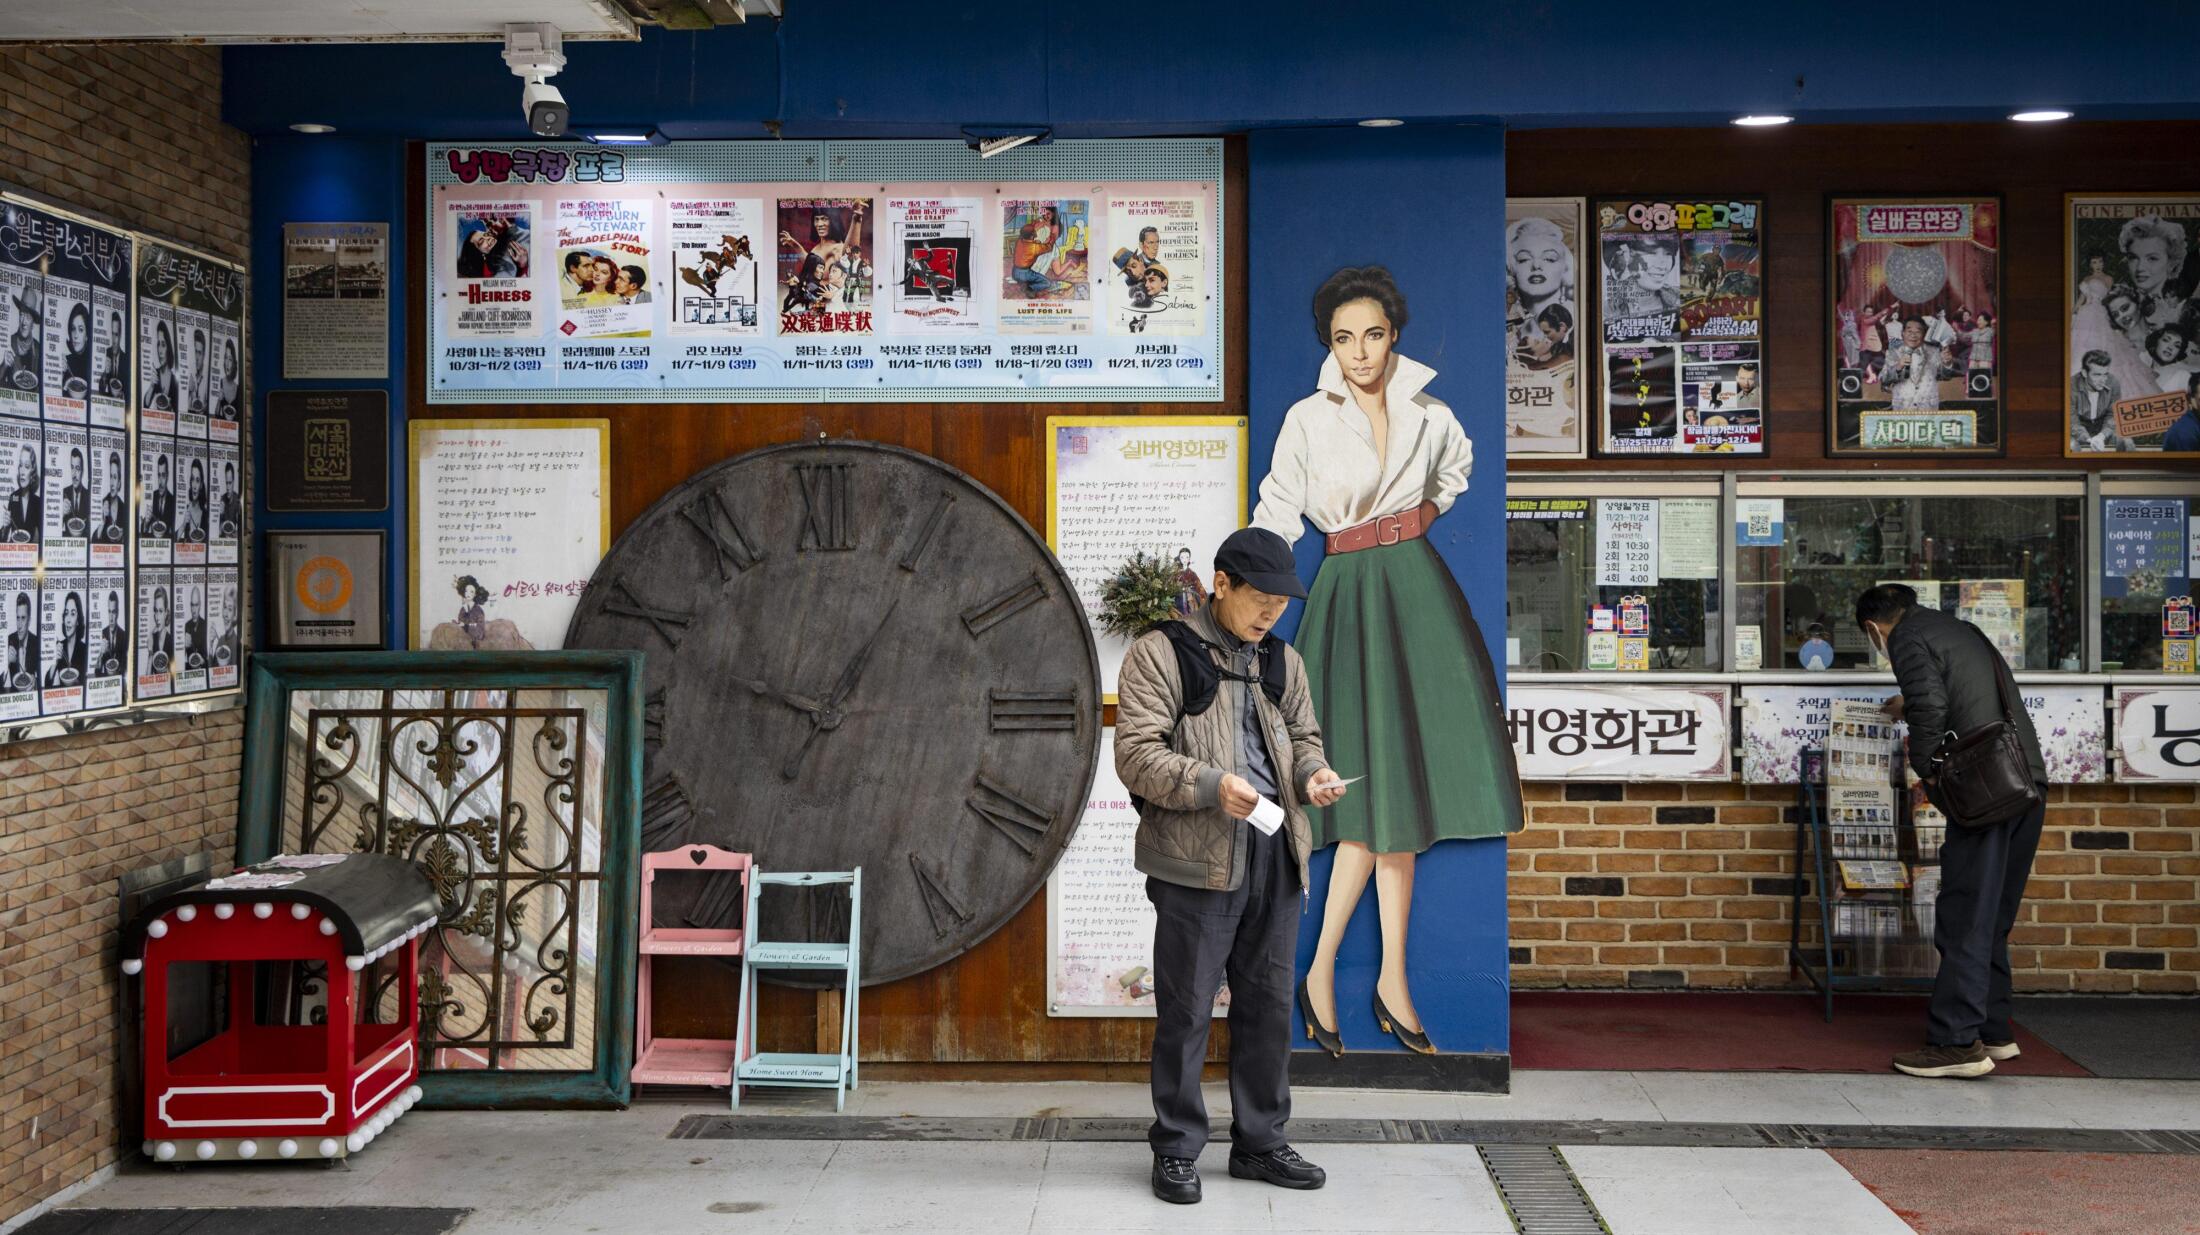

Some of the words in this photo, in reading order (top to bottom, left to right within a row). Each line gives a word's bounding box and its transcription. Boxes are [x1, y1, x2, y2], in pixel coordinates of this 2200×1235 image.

[448, 149, 570, 183] 낭만극장
[575, 151, 625, 183] 프로
[1627, 201, 1758, 231] 영화프로그램
[2077, 205, 2125, 218] CINE
[1870, 209, 1961, 231] 실버공연장
[557, 227, 572, 238] The
[590, 222, 645, 232] STEWART
[559, 232, 640, 247] PHILADELPHIA
[611, 242, 650, 257] STORY
[45, 281, 68, 298] 응답한다
[69, 287, 90, 302] 1988
[469, 283, 531, 304] HEIRESS
[1121, 295, 1197, 313] Sabrina
[446, 347, 476, 358] 사랑아
[480, 347, 500, 358] 나는
[504, 347, 545, 358] 통곡한다
[562, 346, 615, 357] 필라델피아
[618, 346, 650, 357] 스토리
[686, 346, 708, 356] 리오
[711, 346, 743, 356] 브라보
[795, 346, 828, 356] 불타는
[831, 346, 862, 356] 소림사
[880, 345, 921, 355] 북북서로
[924, 345, 957, 355] 진로를
[960, 345, 992, 355] 돌려라
[1011, 345, 1043, 355] 열정의
[1045, 345, 1078, 355] 랩소디
[1135, 344, 1177, 355] 사브리나
[449, 361, 510, 371] 10/31~11/2
[513, 361, 541, 371] (3일)
[563, 360, 617, 370] 11/4~11/6
[620, 360, 648, 370] (3일)
[672, 360, 725, 369] 11/7~11/9
[729, 360, 756, 369] (3일)
[783, 359, 843, 369] 11/11~11/13
[846, 359, 874, 369] (3일)
[888, 359, 951, 369] 11/14~11/16
[954, 359, 982, 369] (3일)
[1065, 359, 1093, 369] (3일)
[1108, 359, 1138, 369] 11/21,
[1142, 359, 1172, 369] 11/23
[1175, 359, 1204, 369] (2일)
[15, 392, 38, 403] WAYNE
[2119, 396, 2186, 422] 낭만극장
[309, 424, 346, 442] 서울
[1873, 419, 1935, 444] 사이다
[1940, 420, 1963, 443] 텍
[2123, 421, 2153, 435] CLASSIC
[22, 427, 41, 441] 1988
[46, 429, 68, 444] 응답한다
[69, 432, 87, 446] 1988
[91, 435, 111, 448] 응답한다
[111, 437, 124, 450] 1988
[1695, 436, 1750, 444] 11/28~12/1
[1120, 439, 1229, 460] 실버영화관
[795, 461, 856, 553] XII
[1551, 500, 1588, 510] 입장불가
[1605, 502, 1650, 511] 상영일정표
[2114, 506, 2176, 519] 상영요금표
[1611, 522, 1643, 532] 사하라
[2109, 529, 2152, 540] 60세이상
[67, 539, 86, 548] TAYLOR
[1605, 540, 1620, 550] 1회
[1626, 541, 1649, 550] 10:30
[2135, 544, 2146, 555] 생
[1605, 551, 1620, 561] 2회
[1626, 552, 1649, 561] 12:20
[1605, 562, 1620, 572] 3회
[1630, 563, 1649, 572] 2:10
[1605, 572, 1620, 582] 4회
[1630, 573, 1649, 582] 4:00
[19, 578, 37, 590] 1988
[43, 578, 67, 590] 응답한다
[69, 578, 87, 590] 1988
[90, 577, 109, 589] 응답한다
[109, 577, 124, 589] 1988
[503, 580, 541, 599] 어르신
[88, 680, 103, 690] GARY
[12, 693, 34, 703] DOUGLAS
[1796, 697, 1831, 709] 추억과
[989, 686, 1078, 734] III
[1506, 707, 1703, 756] 버영화관
[1841, 790, 1880, 799] 실버영화관
[1098, 802, 1107, 811] 더
[1110, 802, 1127, 811] 이상
[650, 945, 681, 953] Flowers
[694, 945, 722, 953] Garden
[759, 952, 790, 961] Flowers
[802, 953, 831, 962] Garden
[641, 1074, 665, 1082] Home
[666, 1074, 691, 1082] Sweet
[693, 1074, 715, 1082] Home
[750, 1068, 774, 1076] Home
[775, 1068, 798, 1076] Sweet
[800, 1068, 824, 1077] Home
